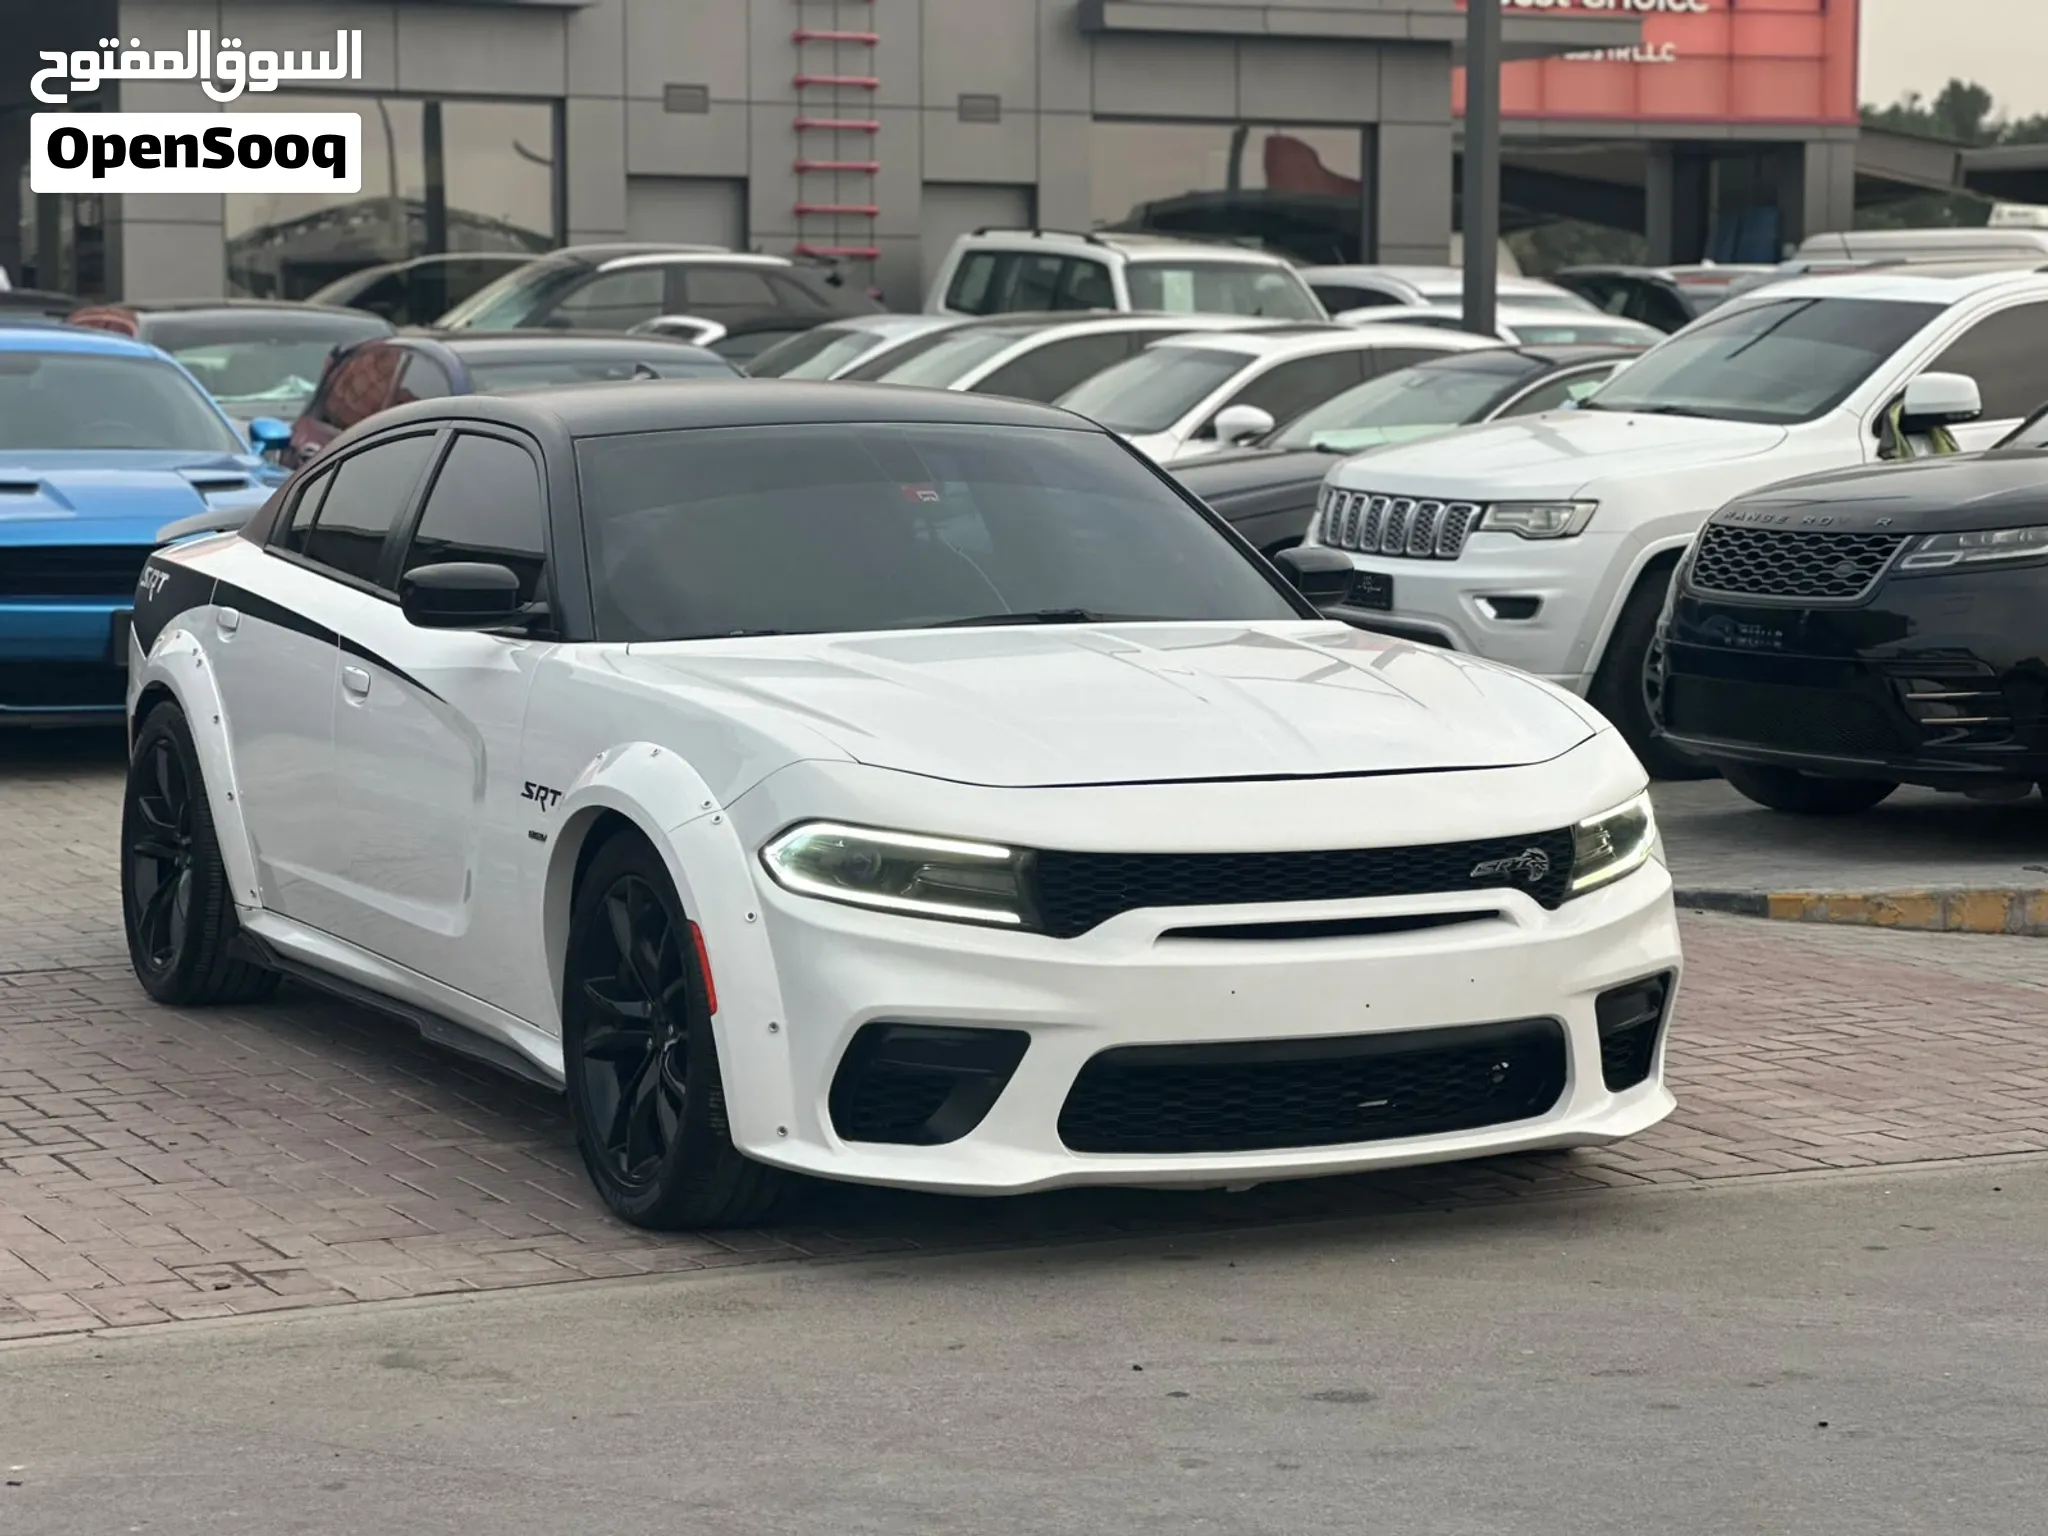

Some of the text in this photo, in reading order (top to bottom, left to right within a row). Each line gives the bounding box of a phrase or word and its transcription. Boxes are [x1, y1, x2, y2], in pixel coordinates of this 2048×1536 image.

[1802, 515, 1893, 528] ROVR
[140, 566, 170, 602] SRT
[520, 780, 562, 813] SRT
